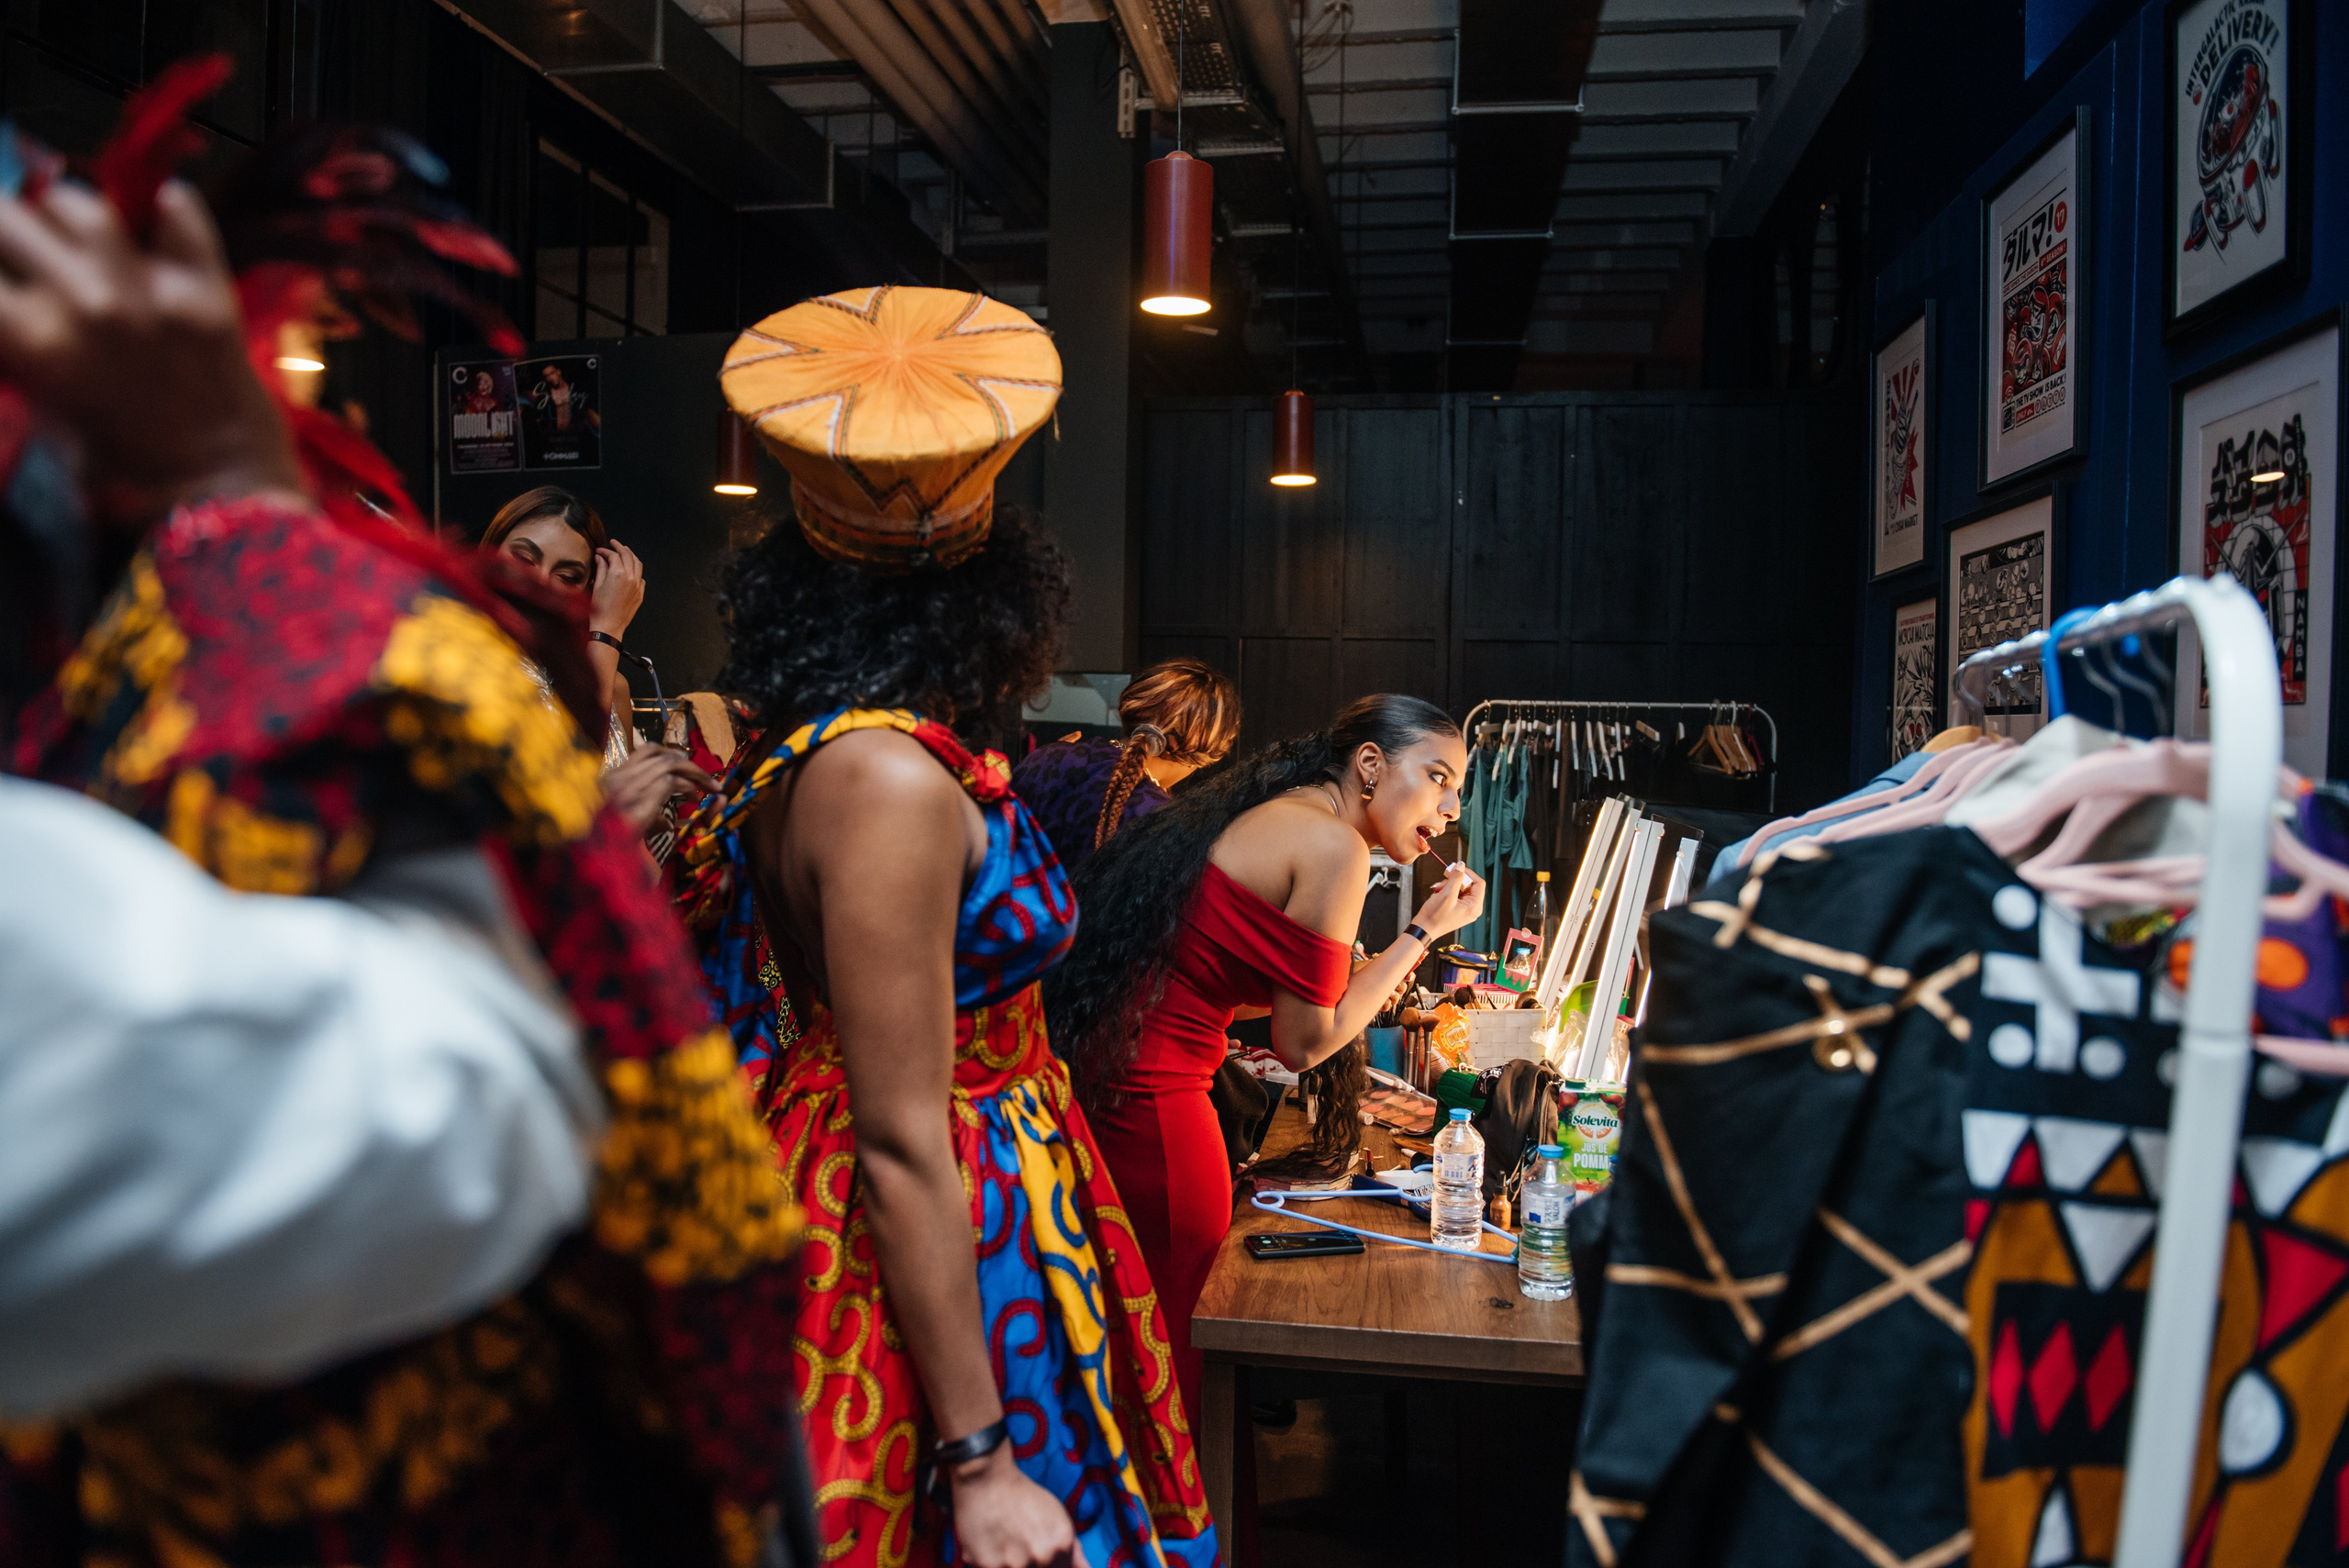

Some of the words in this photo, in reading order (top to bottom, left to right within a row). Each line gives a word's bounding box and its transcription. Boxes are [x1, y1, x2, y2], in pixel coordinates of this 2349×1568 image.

[2199, 9, 2280, 89] DELIVERY!
[2056, 208, 2065, 226] 17
[2030, 385, 2043, 401] SHOW
[1915, 622, 1934, 643] MATCHA
[2295, 595, 2305, 673] NAMBA
[1573, 1115, 1618, 1128] Solevita
[1581, 1142, 1597, 1152] JUS
[1598, 1143, 1608, 1153] DE
